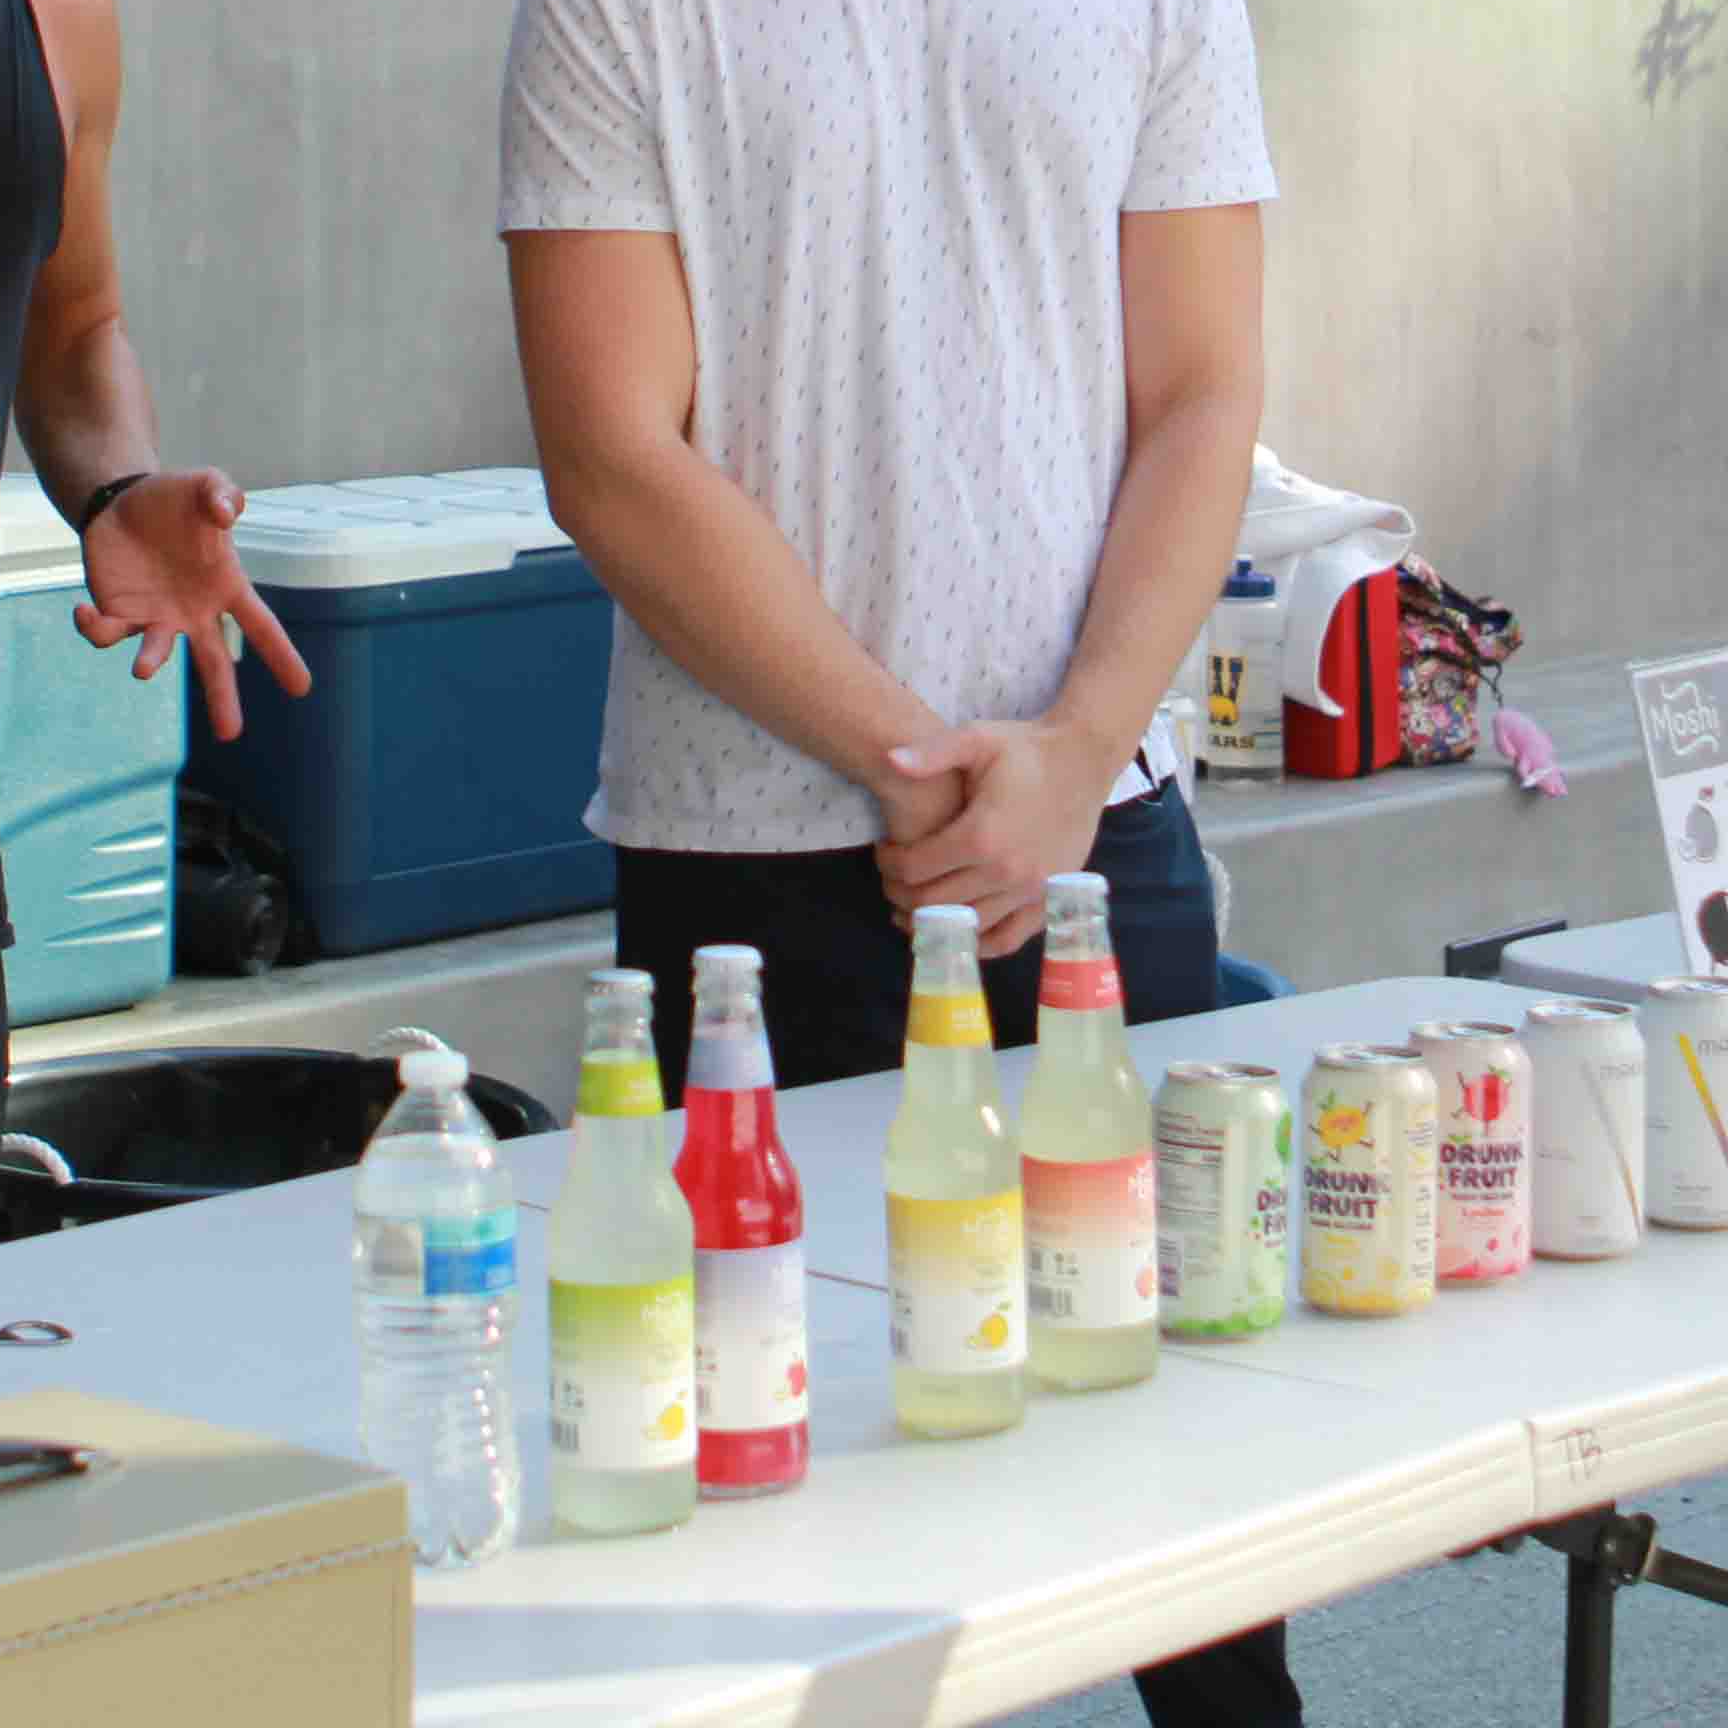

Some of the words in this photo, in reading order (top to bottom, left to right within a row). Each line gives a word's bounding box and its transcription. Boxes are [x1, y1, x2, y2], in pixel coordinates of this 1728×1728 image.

[1648, 700, 1721, 742] Moshi
[1439, 1142, 1523, 1164] DRUNK
[1447, 1167, 1519, 1189] FRUIT
[1308, 1193, 1377, 1219] FRUIT
